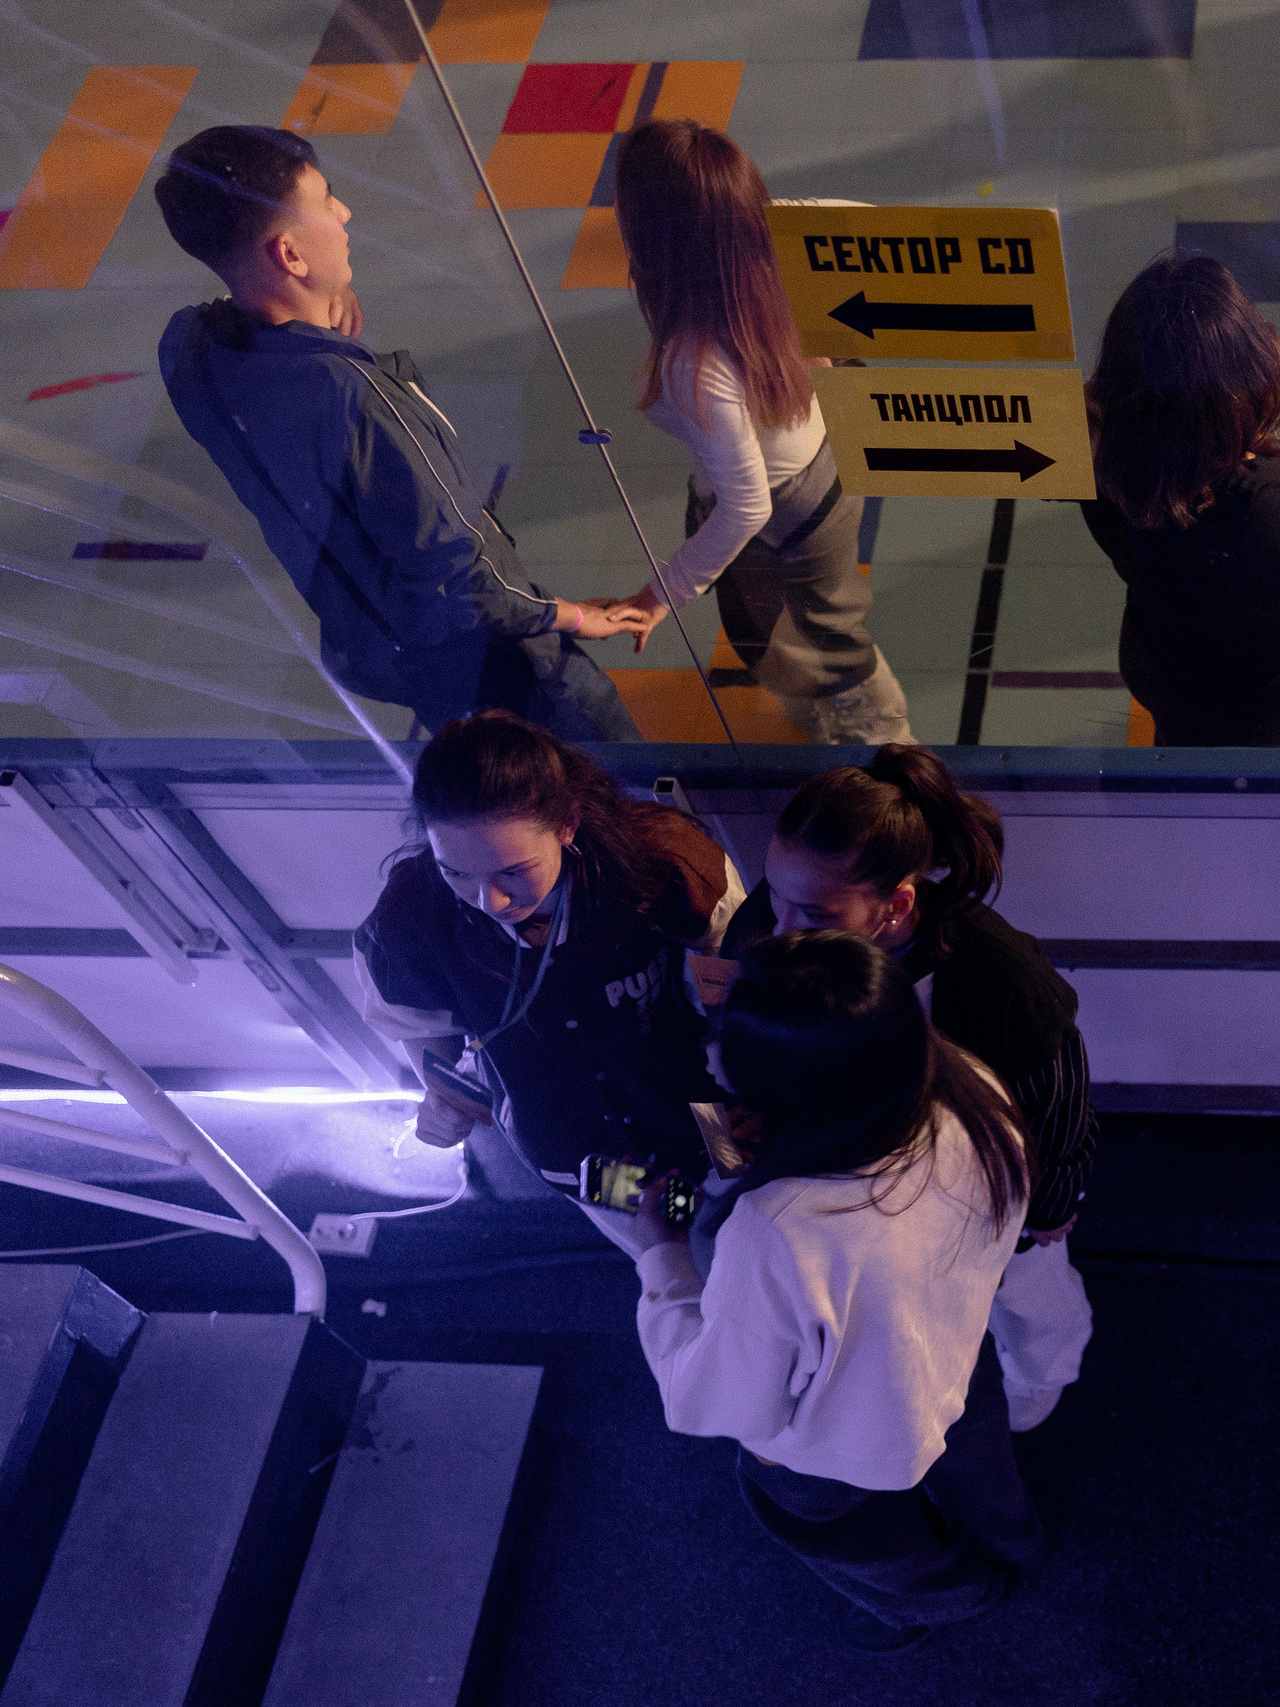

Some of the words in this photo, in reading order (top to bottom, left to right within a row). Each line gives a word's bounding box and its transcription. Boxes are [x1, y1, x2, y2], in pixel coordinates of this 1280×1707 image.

[803, 235, 962, 274] СЕКТОР
[977, 237, 1035, 275] CD
[870, 393, 1032, 426] ТАНЦПОЛ
